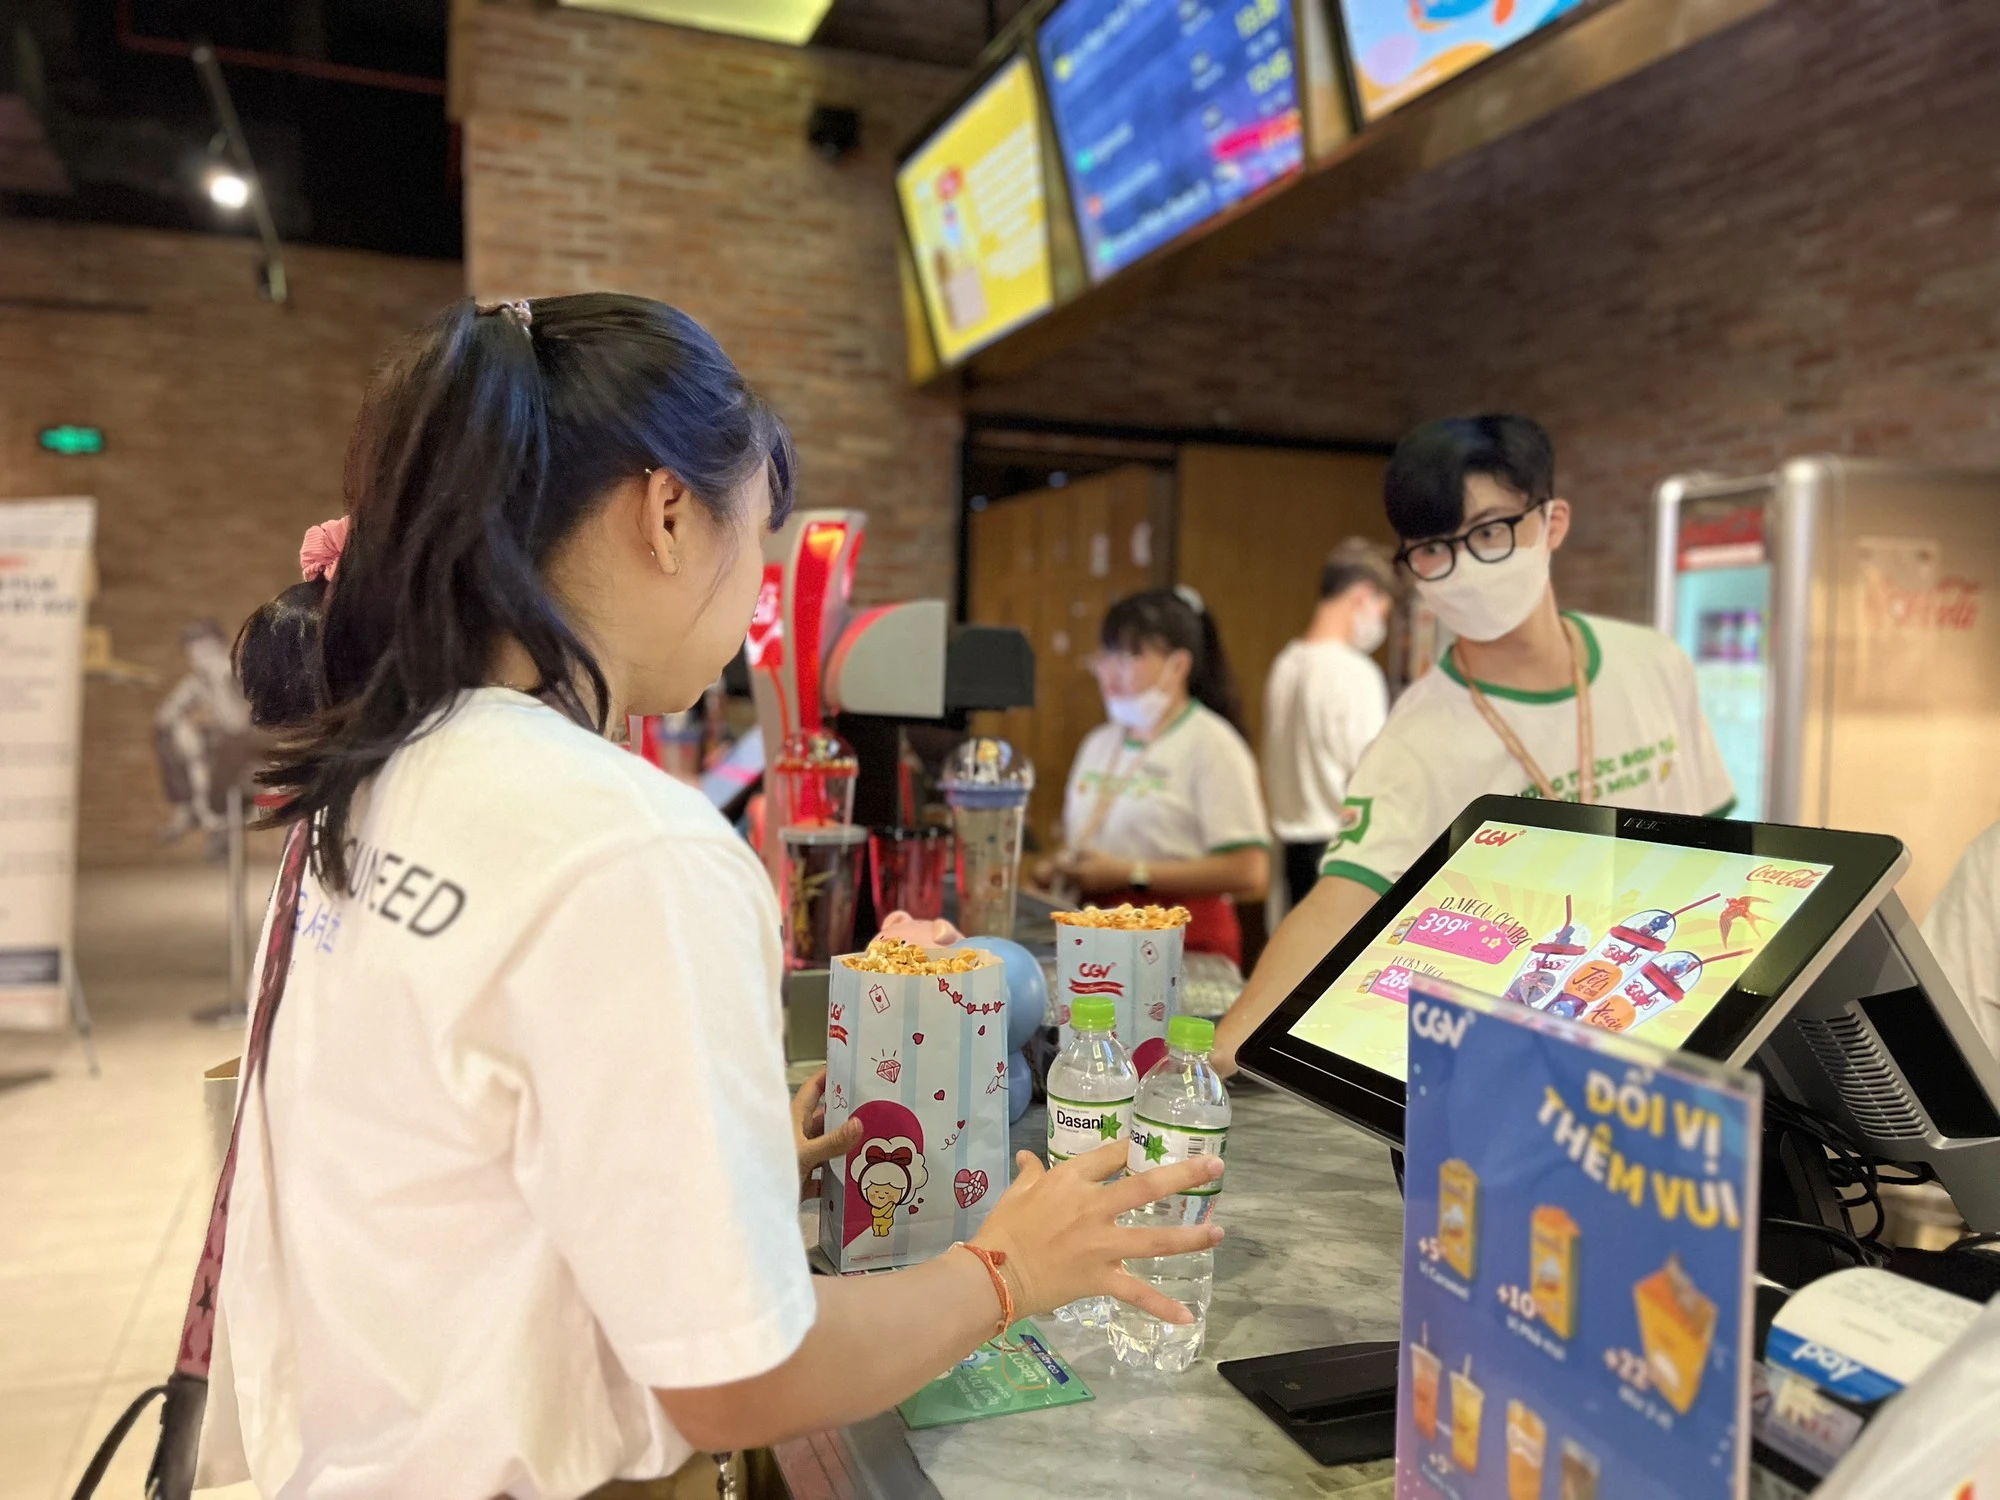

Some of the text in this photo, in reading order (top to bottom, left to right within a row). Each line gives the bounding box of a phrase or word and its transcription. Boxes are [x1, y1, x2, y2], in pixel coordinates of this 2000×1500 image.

[1474, 829, 1517, 847] CGV
[1079, 962, 1112, 979] CGV
[1412, 1001, 1468, 1050] CGV
[1057, 1110, 1104, 1130] Dasani
[1537, 1086, 1740, 1229] THÊM VUI
[1791, 1340, 1863, 1382] pay
